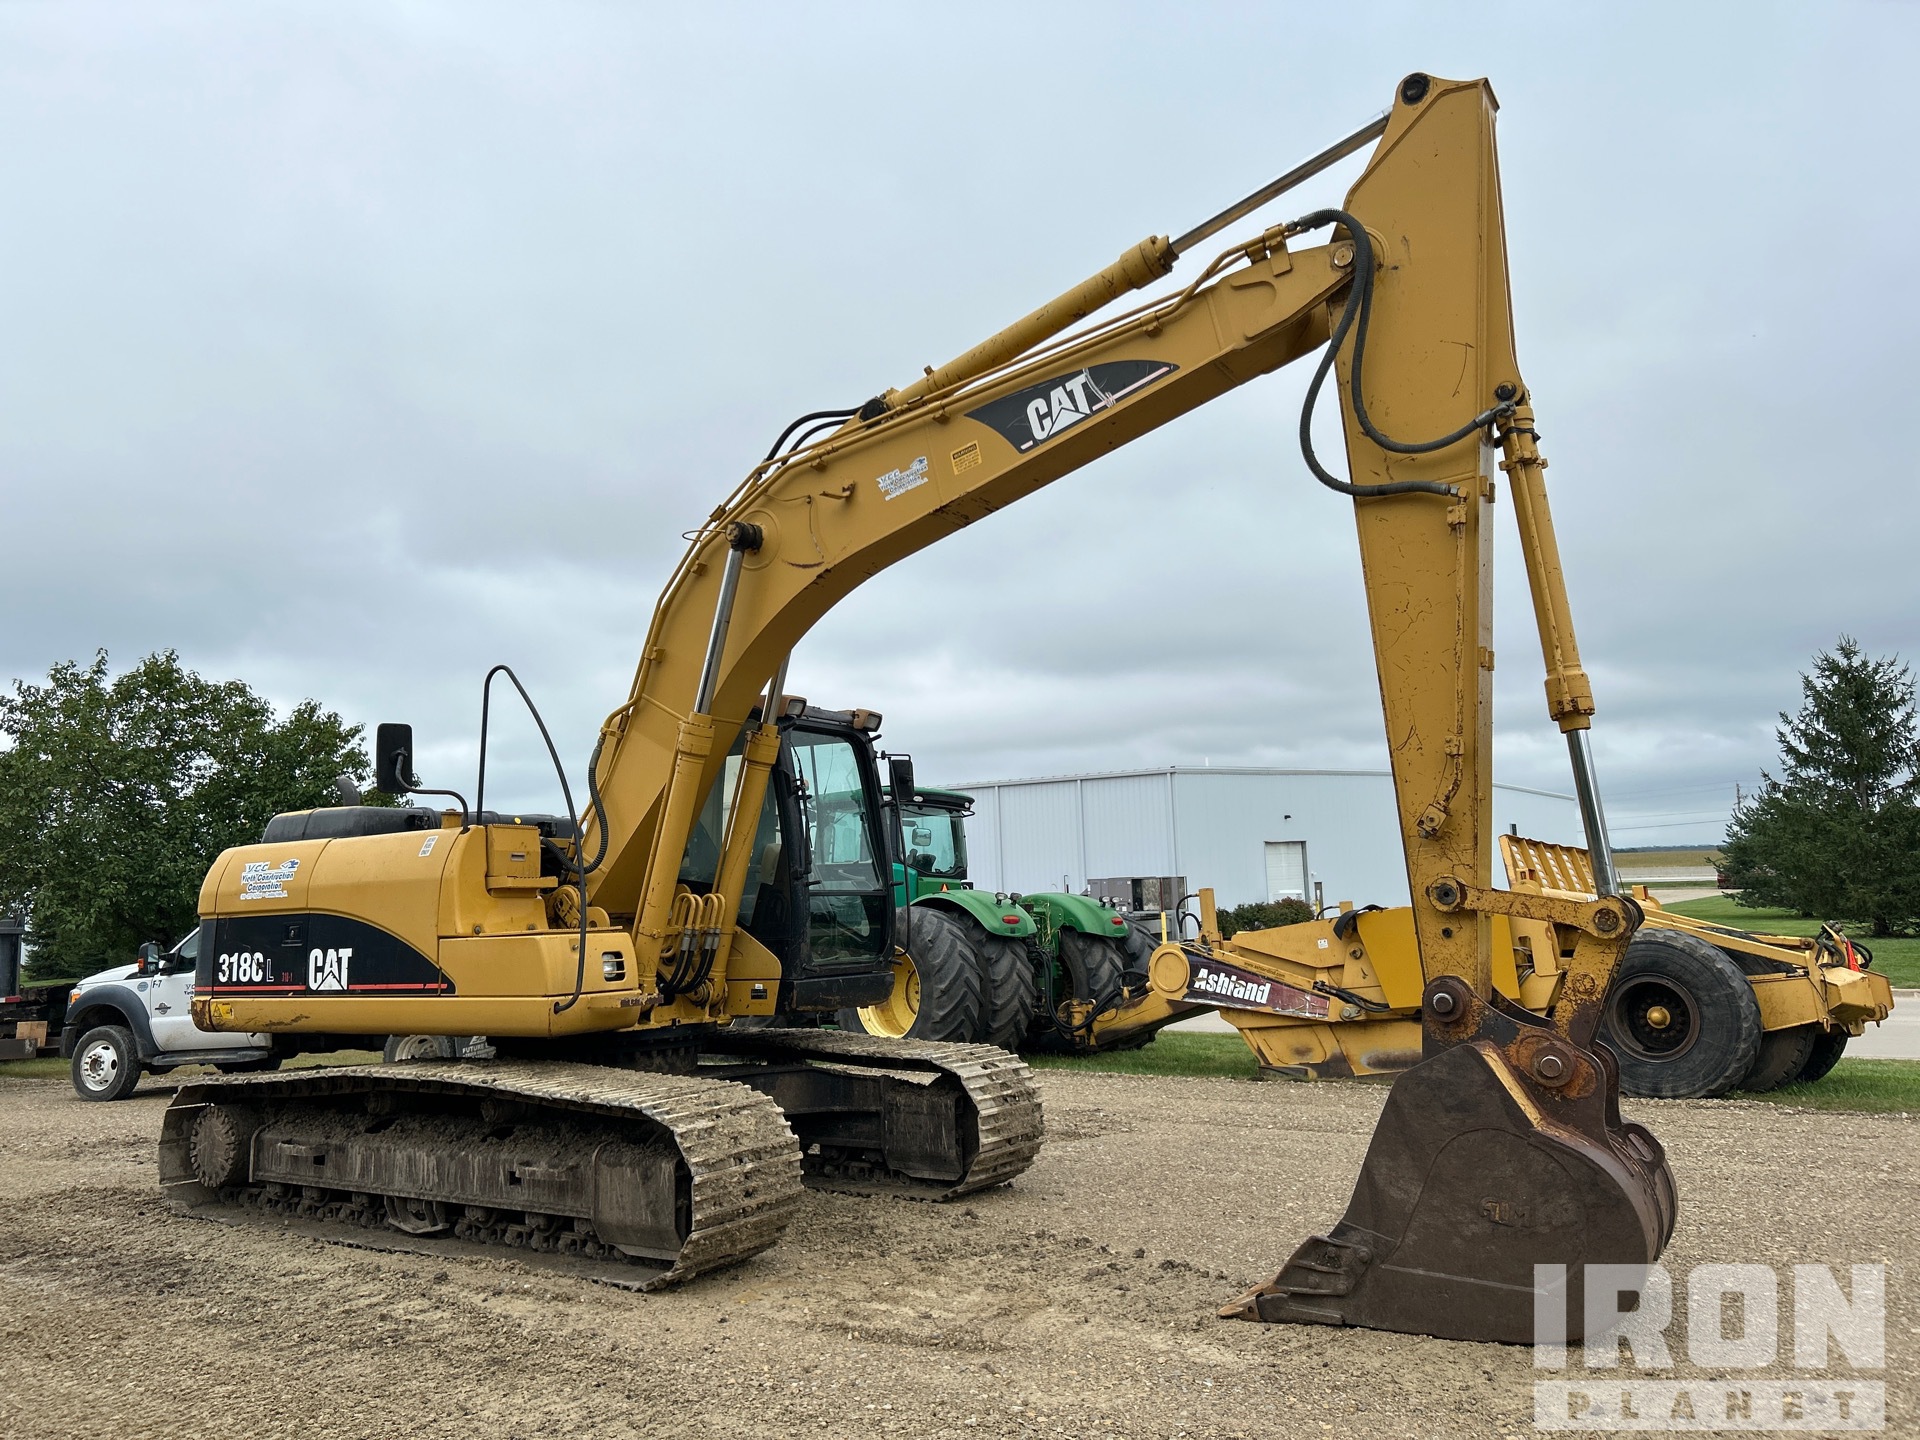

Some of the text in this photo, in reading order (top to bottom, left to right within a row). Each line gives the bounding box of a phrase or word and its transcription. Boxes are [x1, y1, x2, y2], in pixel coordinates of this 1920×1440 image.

[1027, 373, 1091, 440] CAT
[247, 863, 269, 873] VCC
[257, 871, 294, 881] Construction
[247, 881, 282, 892] Corporation
[218, 952, 275, 982] 318C L
[308, 948, 353, 991] CAT
[1193, 967, 1272, 1005] Ashland
